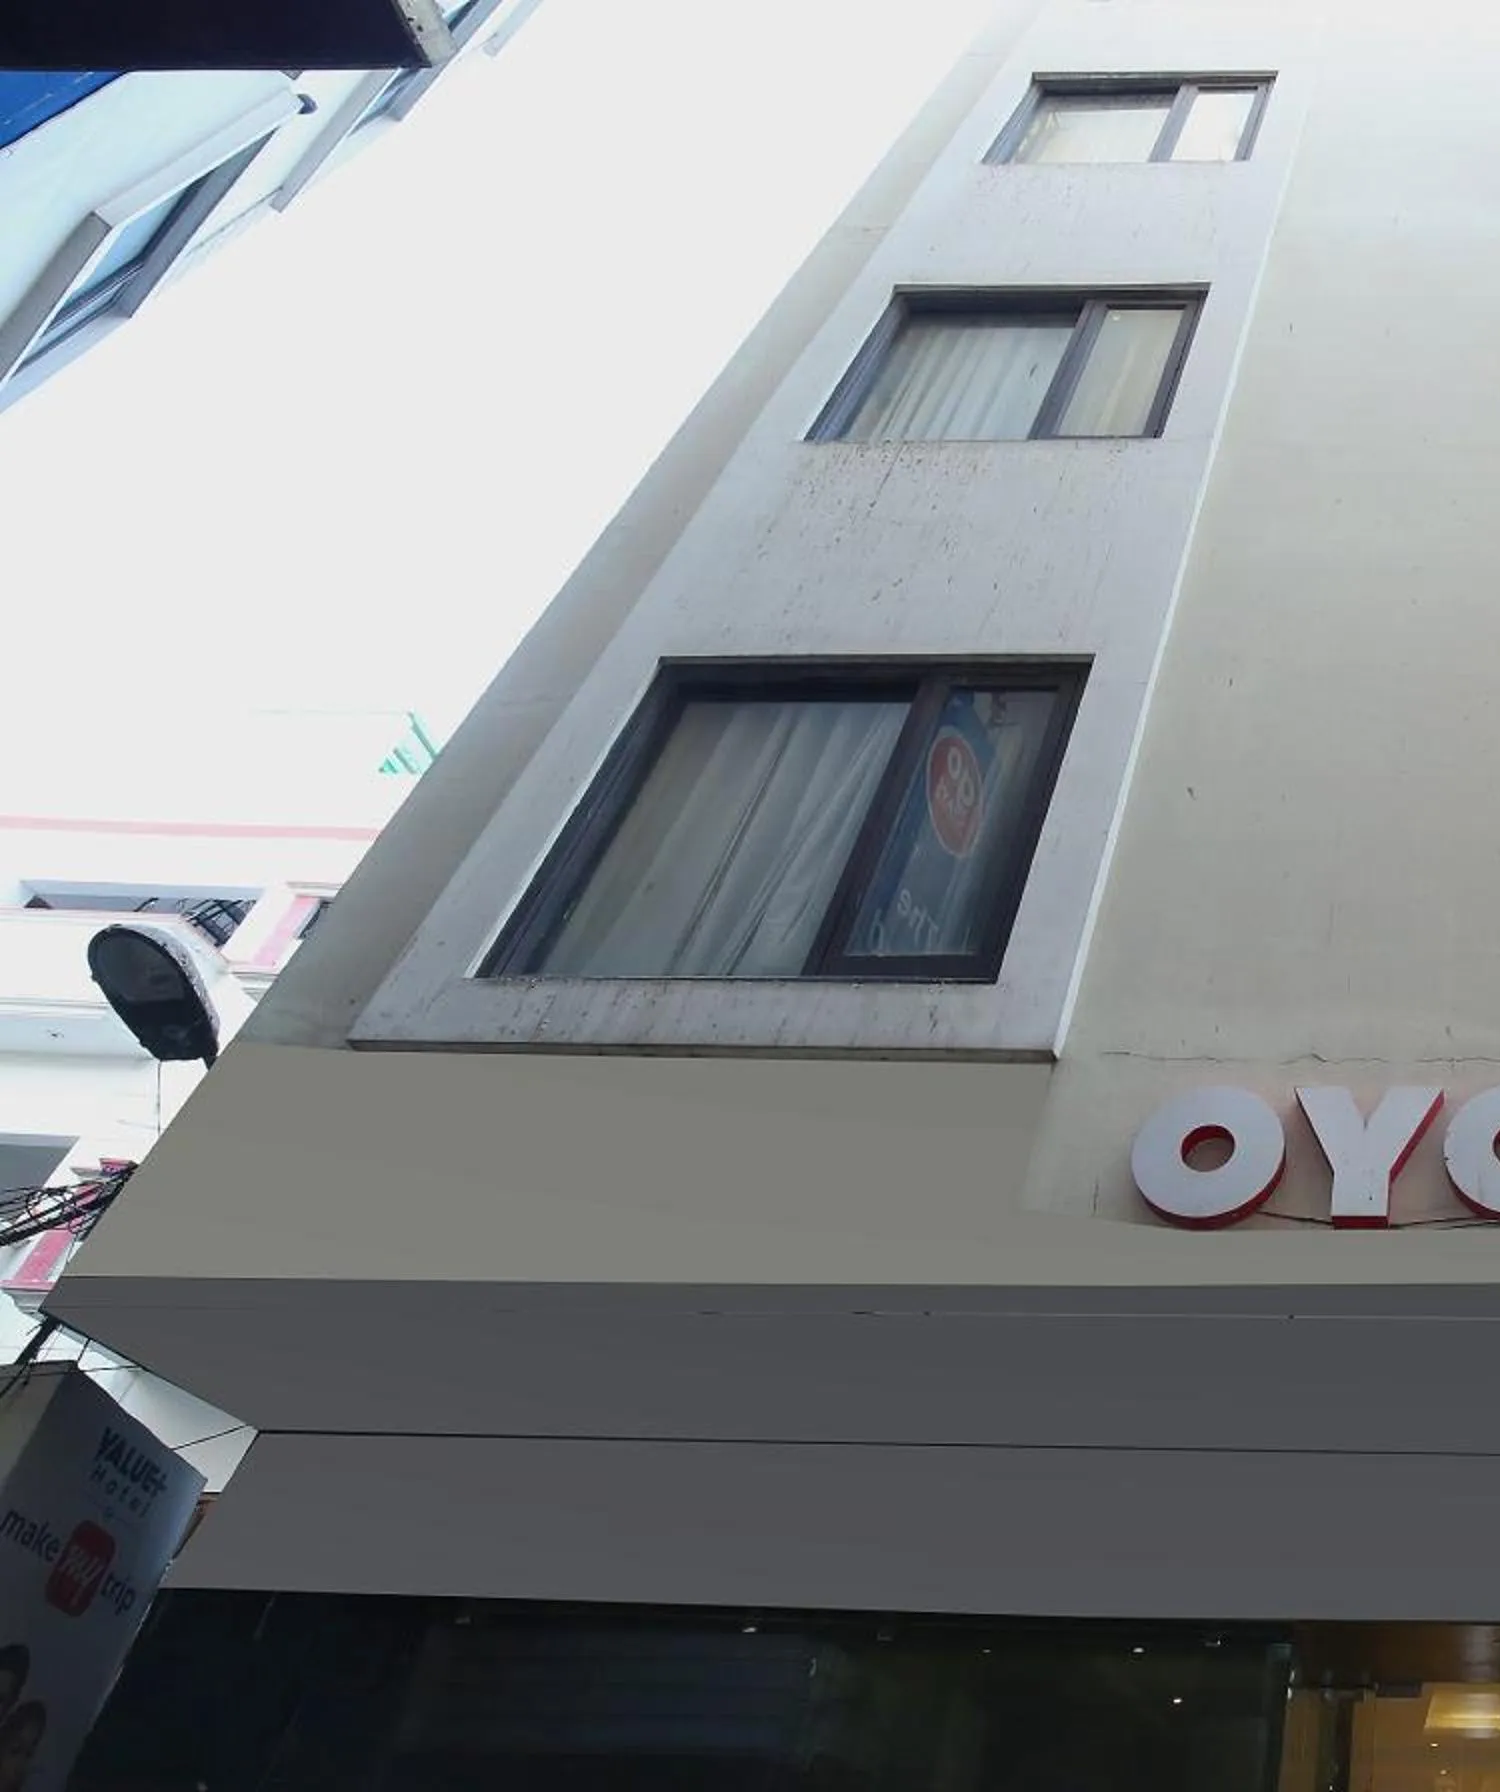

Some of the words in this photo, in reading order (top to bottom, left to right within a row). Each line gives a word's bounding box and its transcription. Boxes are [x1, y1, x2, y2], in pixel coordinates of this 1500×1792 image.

[89, 1464, 152, 1519] Hotel
[0, 1509, 60, 1562] make
[101, 1571, 136, 1616] trip
